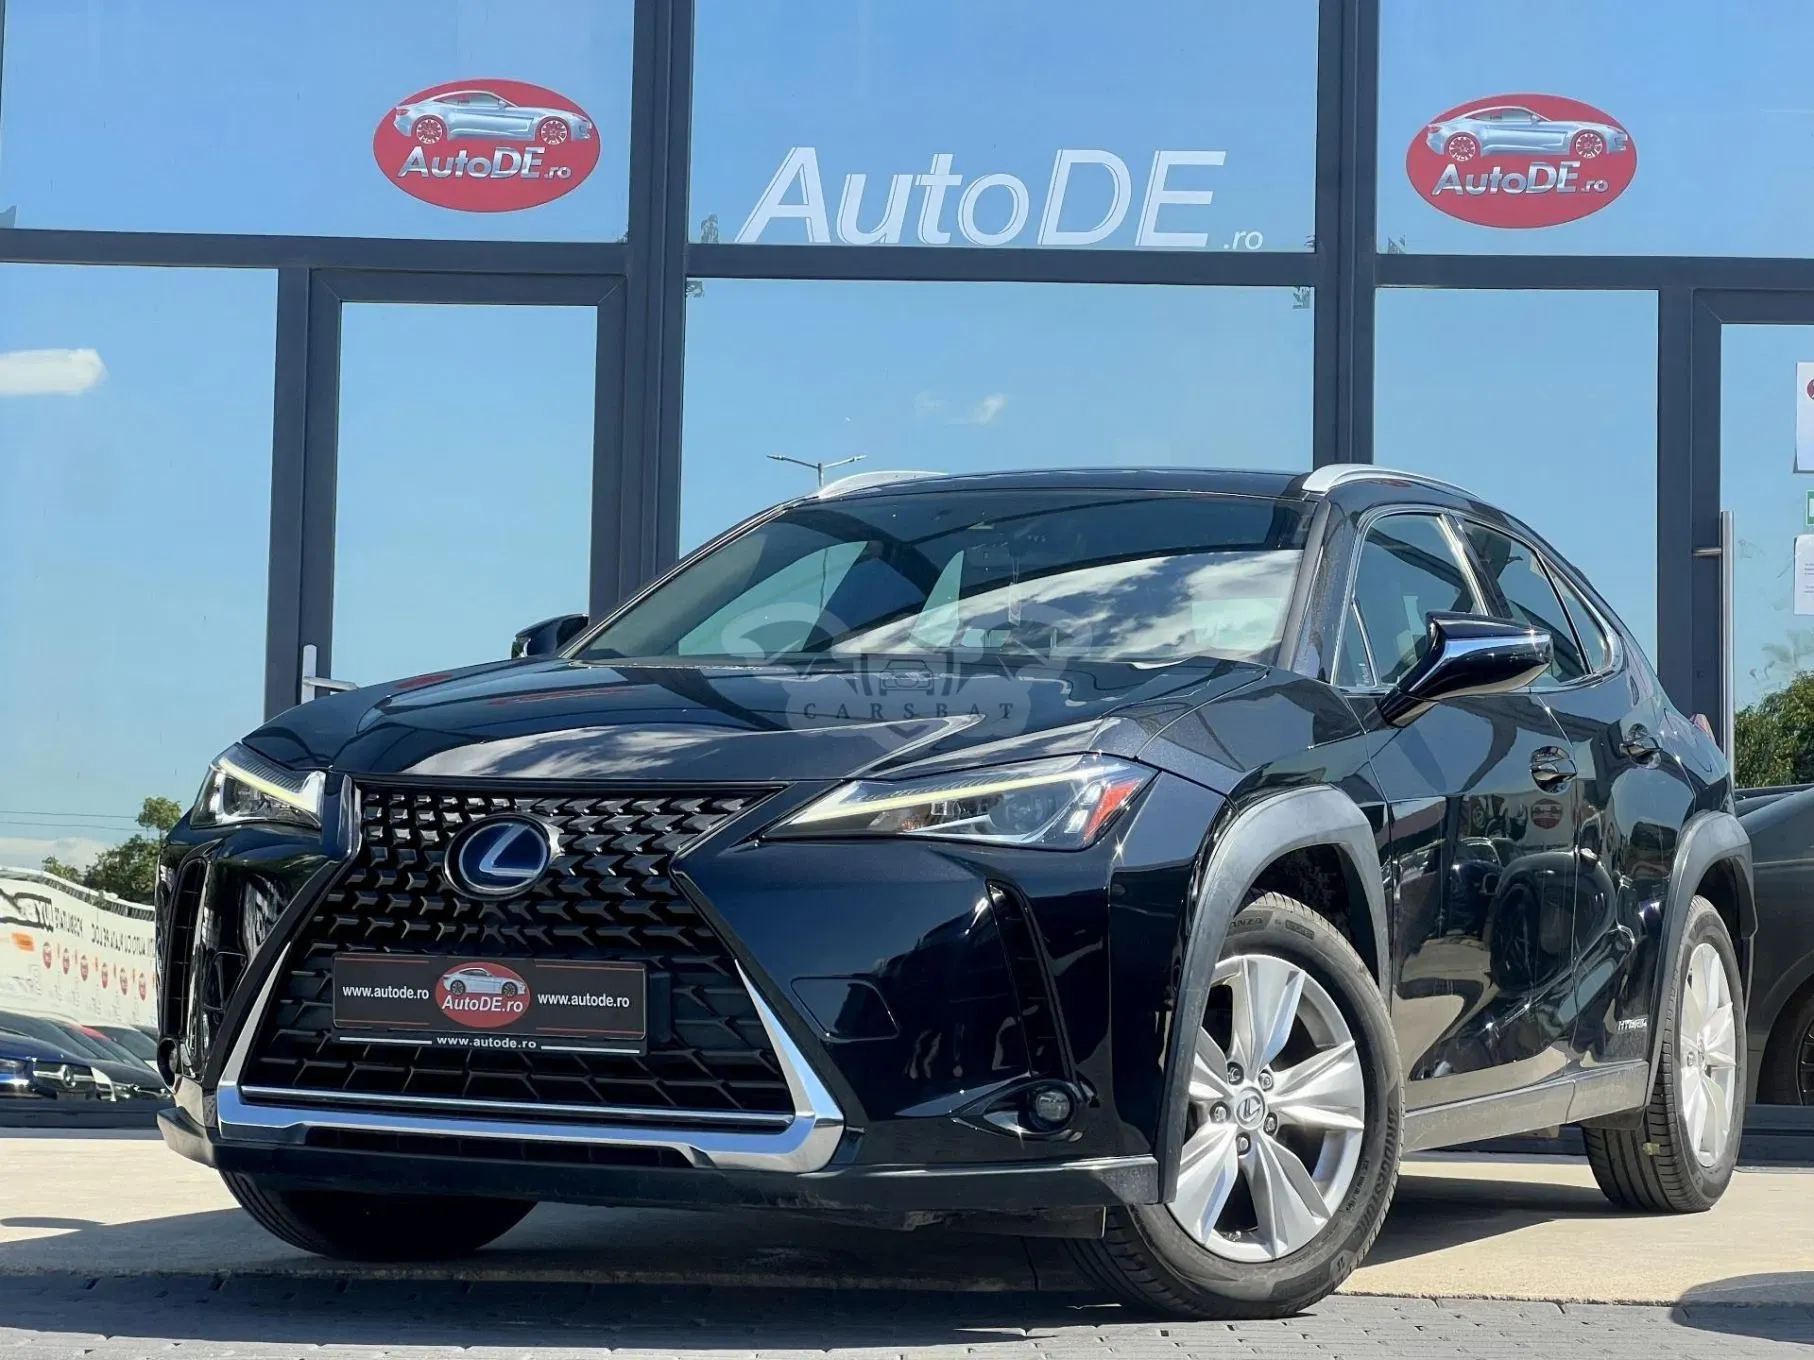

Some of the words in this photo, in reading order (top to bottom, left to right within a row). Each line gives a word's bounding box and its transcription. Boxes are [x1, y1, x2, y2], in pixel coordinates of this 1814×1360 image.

[342, 985, 430, 1001] www.autode.ro
[537, 992, 630, 1008] www.autode.ro
[442, 994, 524, 1014] AutoDE.ro
[436, 1035, 537, 1050] www.autode.ro
